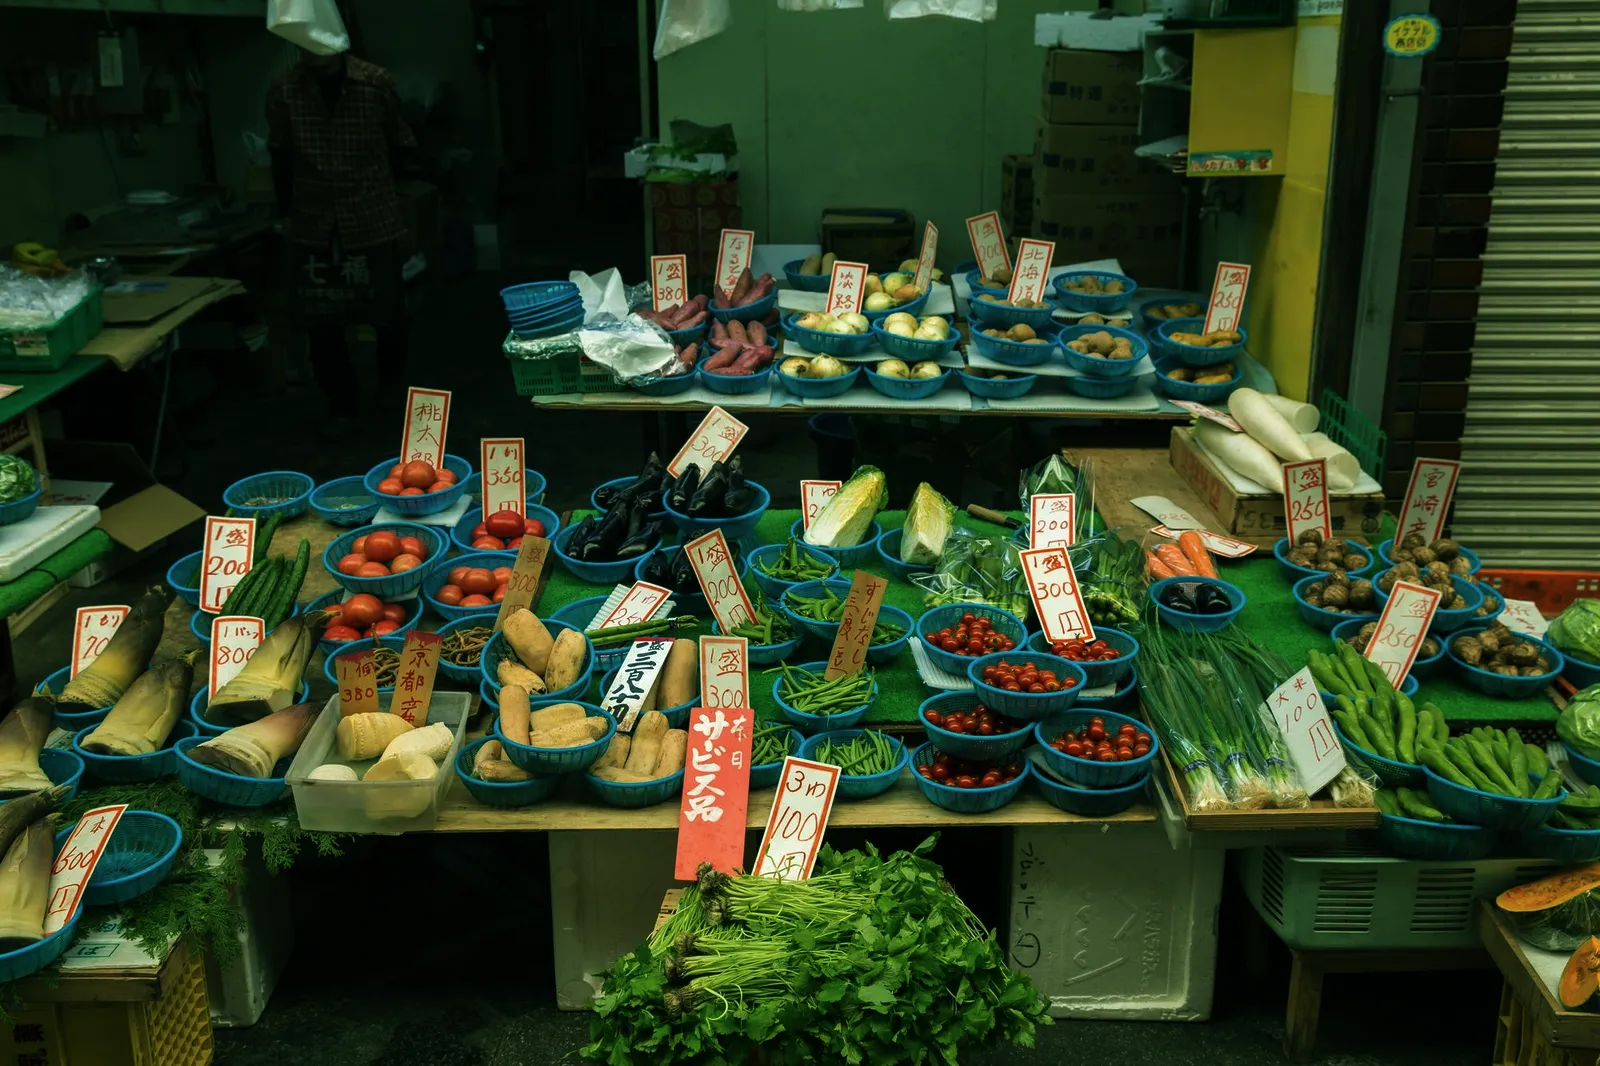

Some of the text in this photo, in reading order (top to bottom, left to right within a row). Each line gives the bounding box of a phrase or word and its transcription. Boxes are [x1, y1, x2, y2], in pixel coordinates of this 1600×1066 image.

[657, 287, 683, 301] 380
[833, 271, 856, 318] 淡路
[1214, 291, 1242, 309] 250
[410, 402, 443, 466] 桃太郎
[691, 435, 723, 462] 300
[486, 466, 521, 486] 350
[809, 503, 826, 518] 2
[1291, 495, 1327, 522] 250
[1036, 519, 1069, 533] 200
[207, 556, 248, 576] 200
[508, 571, 537, 592] 300
[707, 575, 739, 606] 200
[1036, 581, 1075, 600] 300
[1058, 610, 1085, 635] 円
[1378, 623, 1417, 649] 250
[341, 687, 374, 702] 380
[706, 684, 744, 708] 300
[1286, 692, 1317, 733] 100
[730, 714, 748, 770] 本日
[1308, 718, 1340, 762] 円
[770, 806, 818, 842] 100
